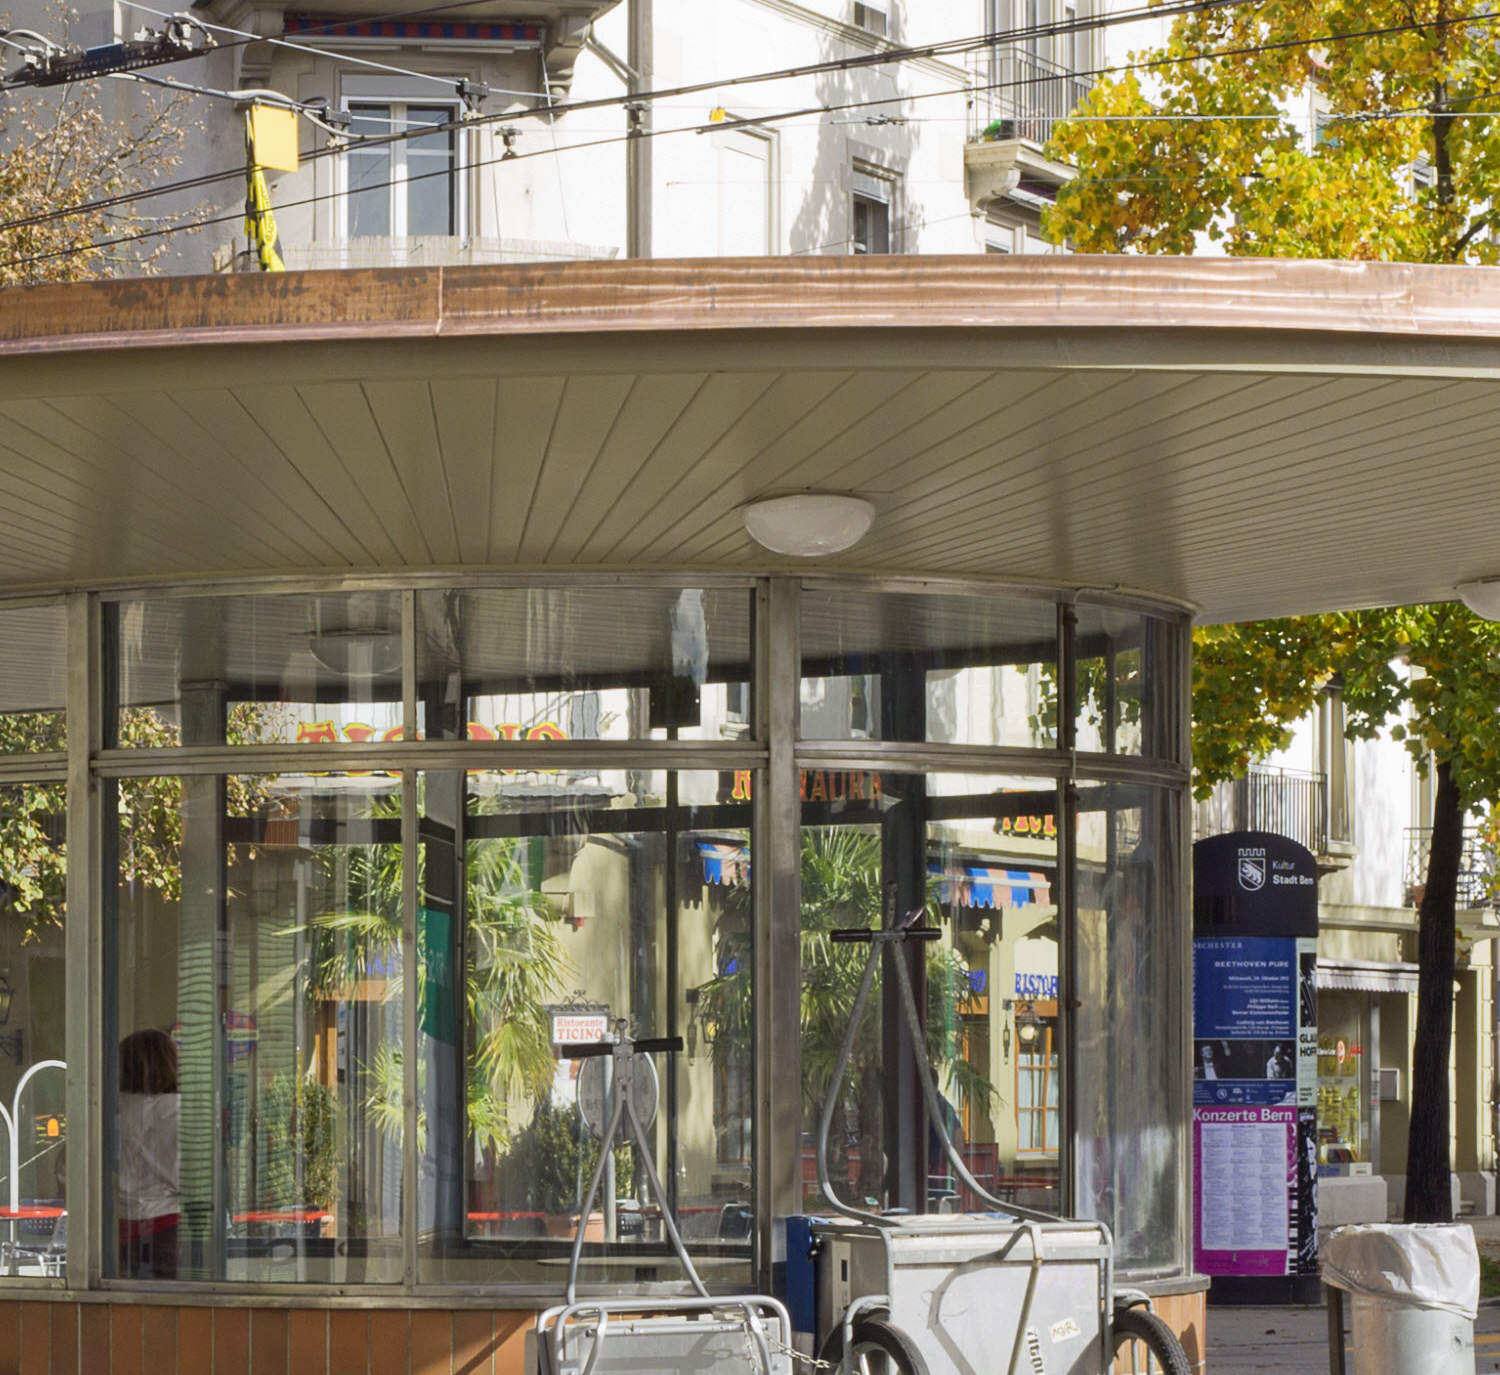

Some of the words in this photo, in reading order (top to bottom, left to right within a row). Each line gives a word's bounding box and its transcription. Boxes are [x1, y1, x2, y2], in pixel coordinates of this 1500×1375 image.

[1272, 860, 1295, 870] Kultur
[1272, 874, 1298, 885] Stadt
[556, 1028, 602, 1040] TICINO
[1193, 1108, 1257, 1122] Konzerte
[1261, 1108, 1293, 1122] Bern
